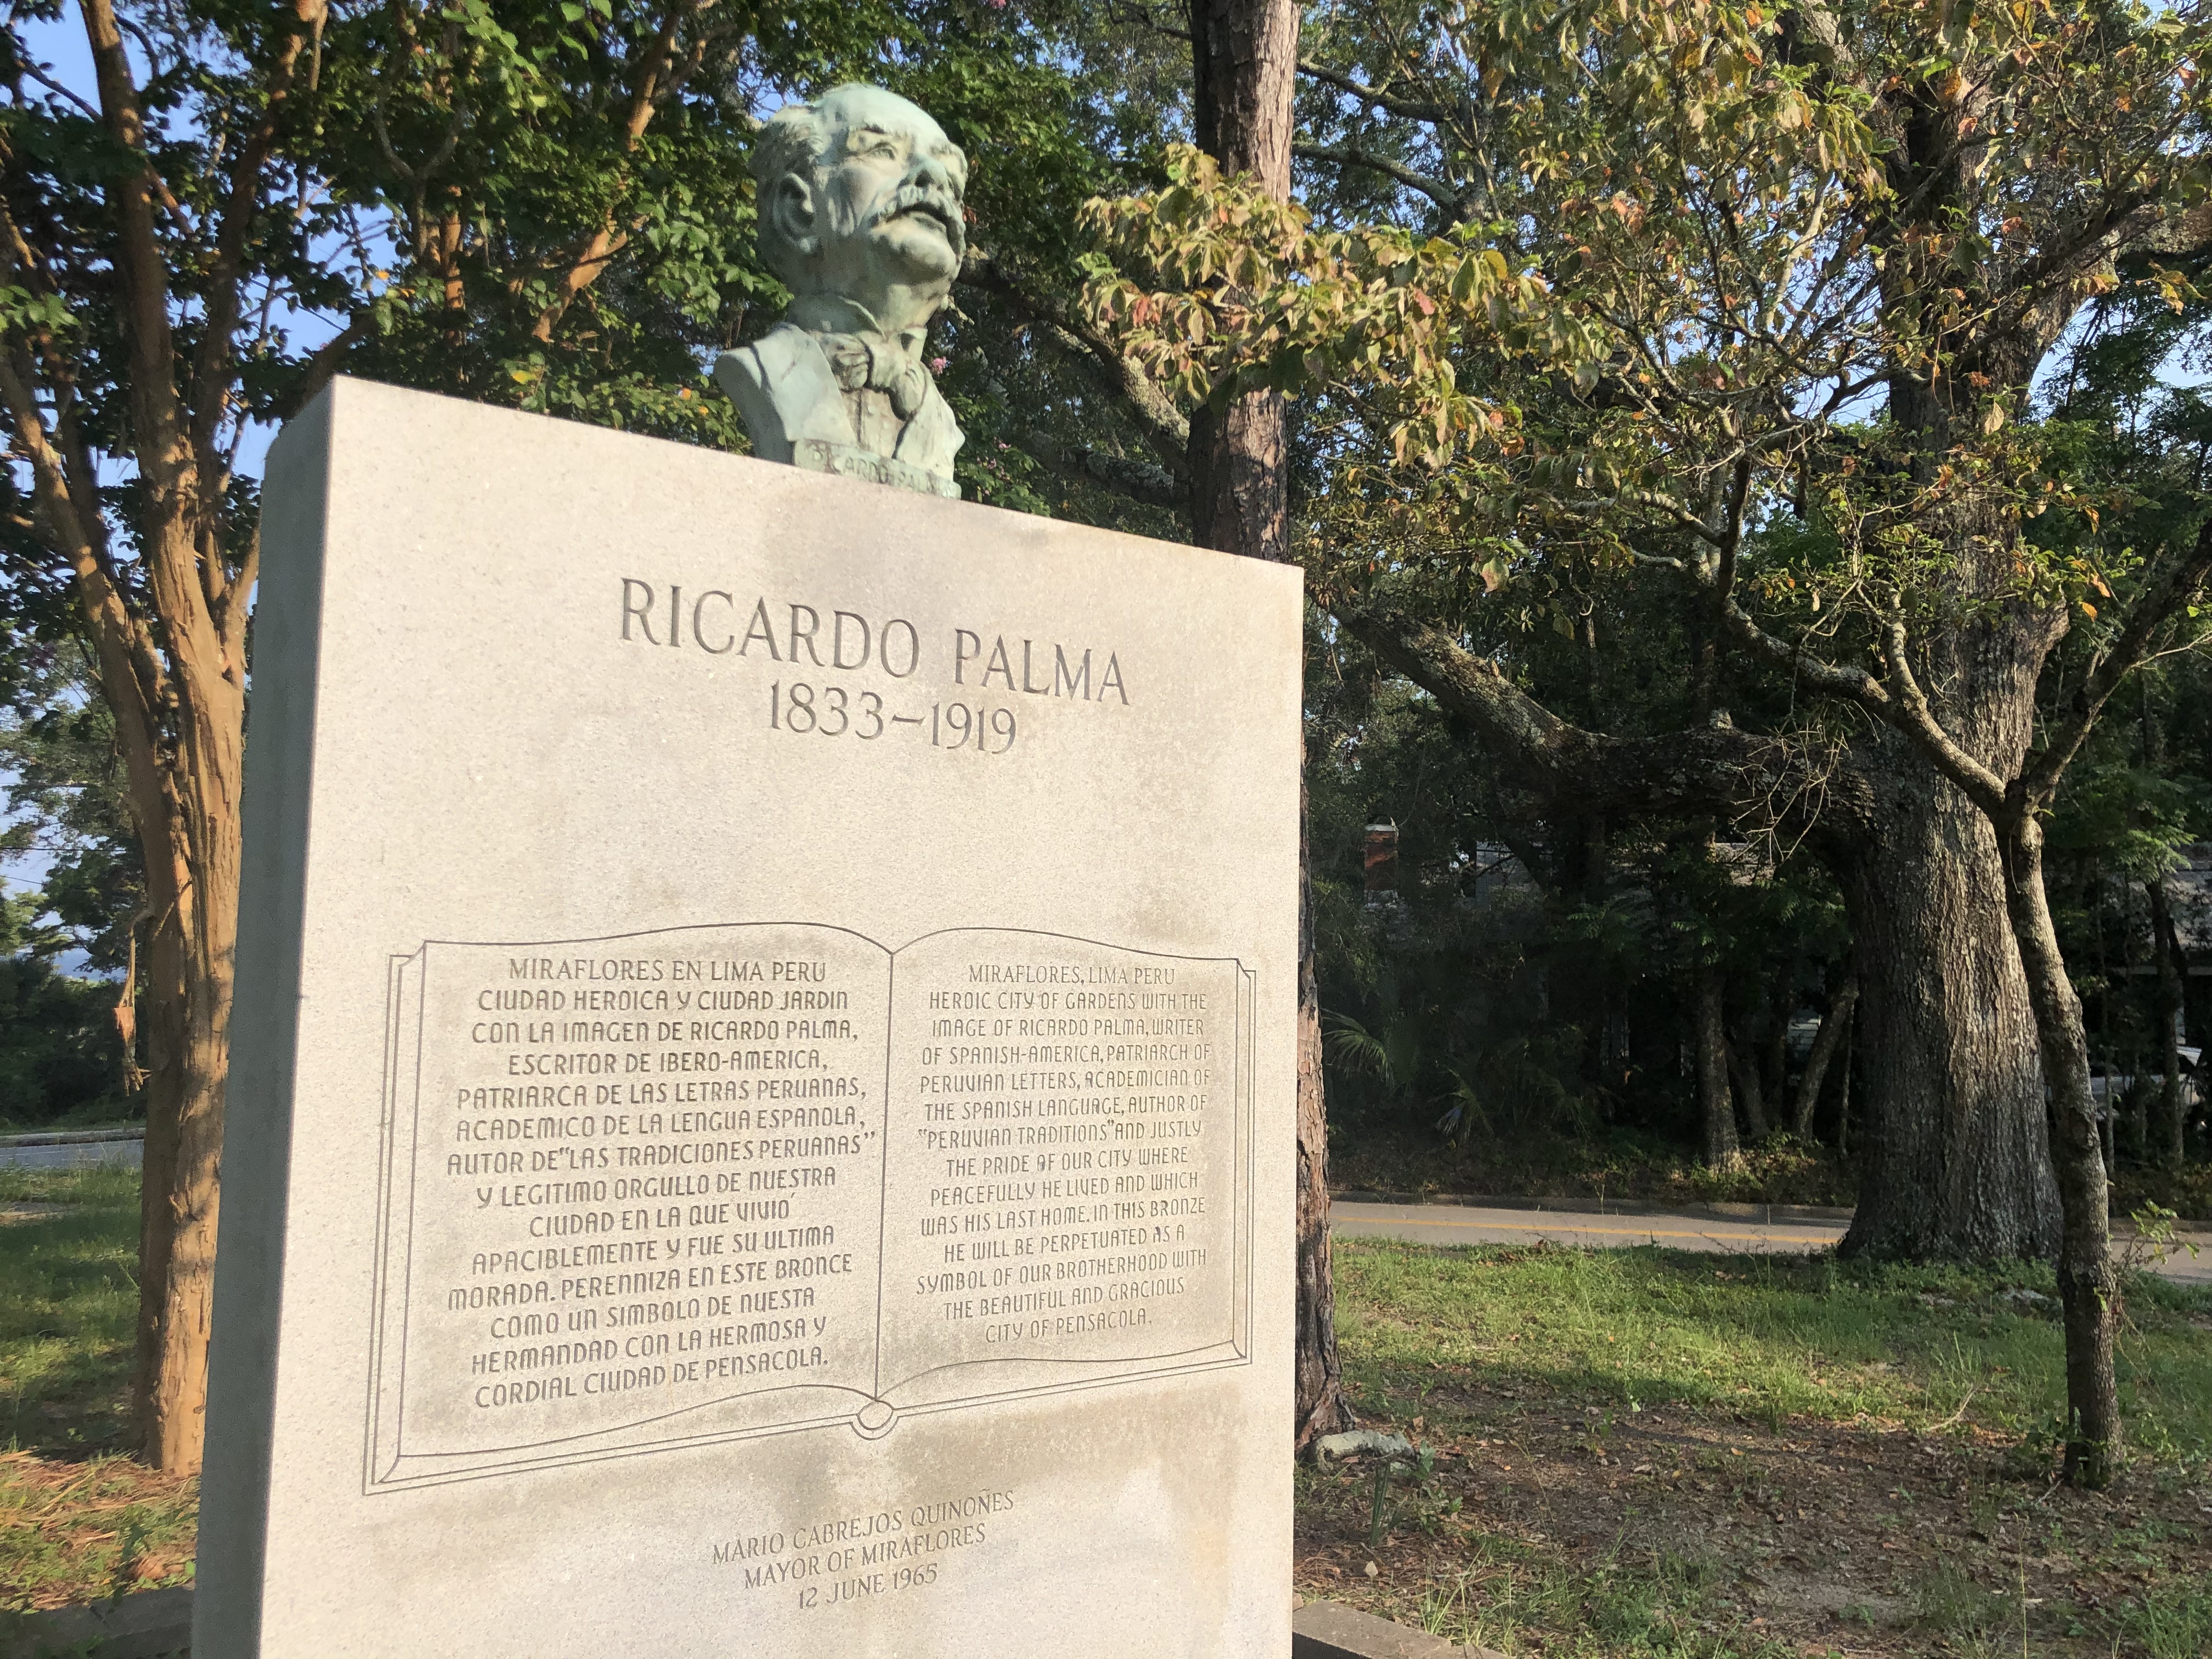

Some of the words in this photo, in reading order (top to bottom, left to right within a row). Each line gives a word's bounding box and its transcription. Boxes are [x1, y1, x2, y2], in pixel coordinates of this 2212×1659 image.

[620, 577, 919, 678] RICARDO
[955, 628, 1130, 706] PALMA
[510, 958, 663, 981] MIRAFLORES
[672, 960, 701, 980] EN
[711, 961, 763, 981] LIMA
[772, 961, 825, 982] PERU
[969, 965, 1084, 985] MIRAFLORES,
[1089, 967, 1128, 984] LIMA
[1135, 967, 1174, 985] PERU
[477, 990, 565, 1011] CIUDAD
[574, 990, 668, 1011] HEROICA
[677, 991, 691, 1010] Y
[698, 991, 773, 1011] CIUDAD
[780, 991, 848, 1011] JARDIN
[930, 991, 991, 1009] HEROIC
[998, 991, 1034, 1009] CITY
[1040, 992, 1058, 1009] OF
[1065, 992, 1135, 1009] GARDENS
[1142, 994, 1176, 1009] WITH
[1182, 994, 1206, 1009] THE
[472, 1022, 519, 1043] CON
[529, 1022, 554, 1043] LA
[563, 1022, 649, 1042] IMAGEN
[658, 1022, 682, 1041] DE
[691, 1020, 778, 1041] RICARDO
[787, 1020, 858, 1041] PALMA,
[933, 1019, 986, 1037] IMAGE
[994, 1019, 1012, 1036] OF
[1020, 1019, 1088, 1036] RICARDO
[1094, 1019, 1149, 1036] PALMA,
[1153, 1019, 1203, 1035] WRITER
[509, 1053, 617, 1075] ESCRITOR
[625, 1053, 651, 1073] DE
[661, 1049, 827, 1072] IBERO-AMERICA,
[922, 1047, 942, 1065] OF
[1107, 1045, 1188, 1061] PATRIARCH
[1195, 1043, 1211, 1060] OF
[458, 1085, 586, 1109] PATRIARCA
[596, 1085, 622, 1105] DE
[630, 1082, 667, 1104] LAS
[675, 1080, 749, 1102] LETRAS
[758, 1077, 866, 1099] PERUANAS,
[921, 1074, 1004, 1093] PERUVIAN
[1012, 1071, 1080, 1091] LETTERS,
[1085, 1069, 1188, 1088] ACADEMICIAN
[1194, 1069, 1209, 1085] OF
[456, 1116, 595, 1142] ACADEMICO
[603, 1115, 629, 1136] DE
[639, 1113, 662, 1134] LA
[672, 1110, 750, 1133] LENGUA
[757, 1106, 865, 1128] ESPANOLA,
[925, 1103, 955, 1121] THE
[962, 1101, 1032, 1120] SPANISH
[1039, 1097, 1124, 1116] LANGUAGE,
[1128, 1096, 1184, 1113] AUTHOR
[1191, 1094, 1206, 1111] OF
[1115, 1122, 1144, 1139] AND
[1150, 1120, 1201, 1138] JUSTLY
[448, 1152, 523, 1175] AUTOR
[532, 1147, 557, 1171] DE
[617, 1141, 753, 1166] TRADICIONES
[946, 1158, 976, 1177] THE
[983, 1155, 1029, 1175] PRIDE
[1062, 1152, 1092, 1170] OUR
[1098, 1149, 1132, 1168] CITY
[1139, 1147, 1187, 1165] WHERE
[477, 1187, 492, 1209] Y
[501, 1181, 606, 1207] LEGITIMO
[614, 1175, 709, 1200] ORGULLO
[717, 1172, 741, 1193] DE
[749, 1166, 836, 1190] NUESTRA
[931, 1182, 1035, 1206] PEACEFULLY
[1043, 1180, 1061, 1198] HE
[1067, 1178, 1109, 1197] LIVED
[1115, 1175, 1144, 1193] AND
[1152, 1172, 1197, 1191] WHICH
[529, 1212, 614, 1237] CIUDAD
[622, 1209, 648, 1230] EN
[657, 1206, 680, 1228] LA
[690, 1204, 729, 1226] QUE
[921, 1216, 957, 1237] WAS
[965, 1213, 990, 1232] HIS
[997, 1210, 1035, 1229] LAST
[1041, 1206, 1090, 1226] HOME.
[1094, 1204, 1108, 1221] IN
[1114, 1201, 1144, 1220] THIS
[1150, 1197, 1205, 1217] BRONZE
[472, 1240, 657, 1275] APACIBLEMENTE
[667, 1238, 680, 1259] Y
[688, 1234, 724, 1257] FUE
[732, 1232, 757, 1253] SU
[765, 1225, 834, 1250] ULTIMA
[945, 1244, 964, 1263] HE
[973, 1240, 1009, 1260] WILL
[1015, 1237, 1034, 1255] BE
[1041, 1228, 1147, 1253] PERPETUATED
[1153, 1226, 1170, 1243] AS
[1177, 1224, 1184, 1240] A
[448, 1281, 555, 1311] MORADA.
[562, 1269, 680, 1300] PERENNIZA
[689, 1267, 713, 1288] EN
[721, 1261, 766, 1284] ESTE
[776, 1254, 852, 1279] BRONCE
[916, 1271, 986, 1295] SYMBOL
[994, 1268, 1012, 1286] OF
[1020, 1264, 1051, 1284] OUR
[1057, 1253, 1167, 1279] BROTHERHOOD
[1173, 1249, 1206, 1268] WITH
[490, 1313, 558, 1339] COMO
[568, 1309, 596, 1331] UN
[606, 1299, 699, 1327] SIMBOLO
[708, 1295, 731, 1317] DE
[741, 1287, 814, 1313] NUESTA
[944, 1301, 973, 1320] THE
[980, 1290, 1065, 1316] BEAUTIFUL
[1072, 1286, 1103, 1305] AND
[1109, 1277, 1184, 1301] GRACIOUS
[986, 1323, 1023, 1343] CITY
[1031, 1319, 1049, 1338] OF
[1057, 1308, 1152, 1335] PENSACOLA.
[472, 1340, 617, 1374] HERMANDAD
[625, 1334, 669, 1358] CON
[679, 1330, 701, 1351] LA
[710, 1318, 805, 1347] HERMOSA
[814, 1316, 826, 1336] Y
[475, 1377, 577, 1408] CORDIAL
[584, 1366, 665, 1394] CIUDAD
[673, 1361, 699, 1383] DE
[706, 1346, 828, 1379] PENSACOLA.
[713, 1533, 784, 1564] MARIO
[793, 1510, 901, 1549] CABREJOS
[911, 1488, 1013, 1526] QUINOÑES
[745, 1556, 820, 1589] MAYOR
[828, 1548, 854, 1572] OF
[862, 1523, 985, 1565] MIRAFLORES
[799, 1587, 817, 1609] 12
[826, 1573, 884, 1604] JUNE
[893, 1562, 937, 1589] 1965
